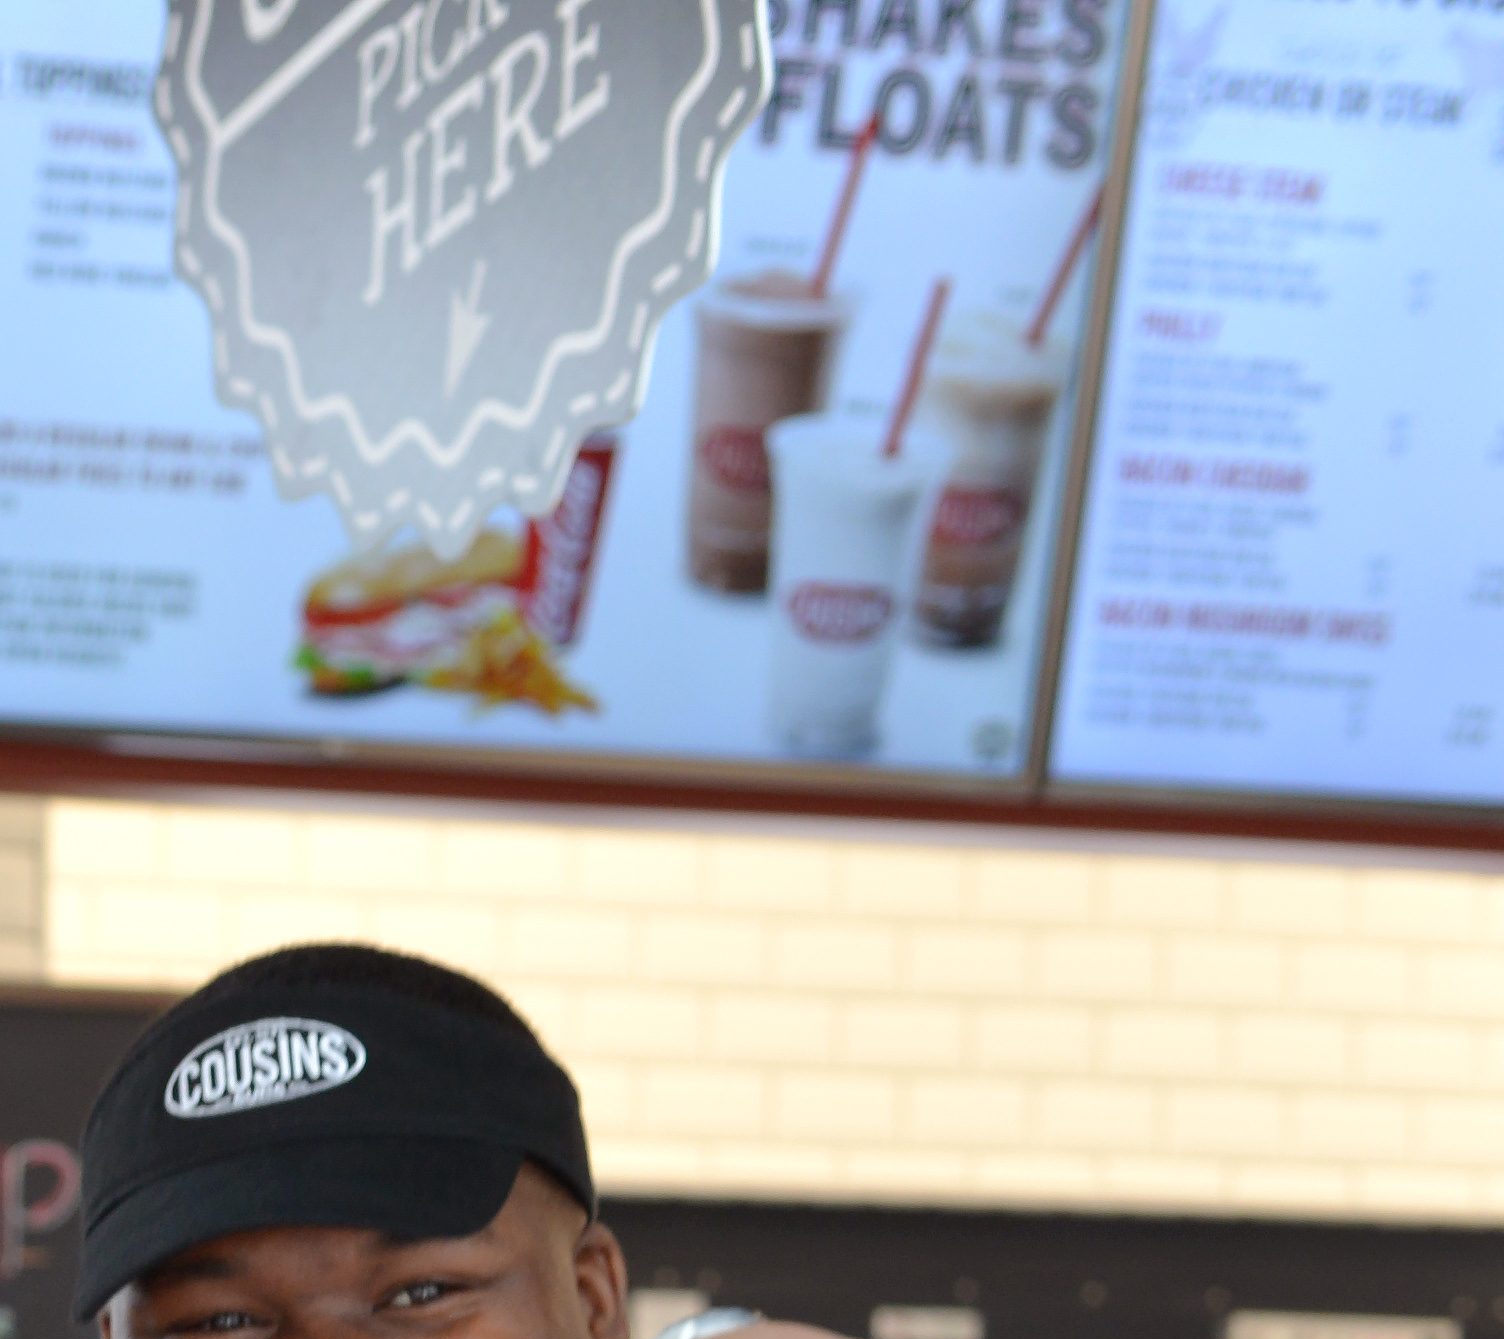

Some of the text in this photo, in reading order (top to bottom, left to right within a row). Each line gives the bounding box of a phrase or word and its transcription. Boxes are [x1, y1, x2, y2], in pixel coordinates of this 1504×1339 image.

[361, 0, 610, 304] HERE
[759, 57, 1095, 170] FLOATS
[178, 1031, 349, 1112] COUSINS
